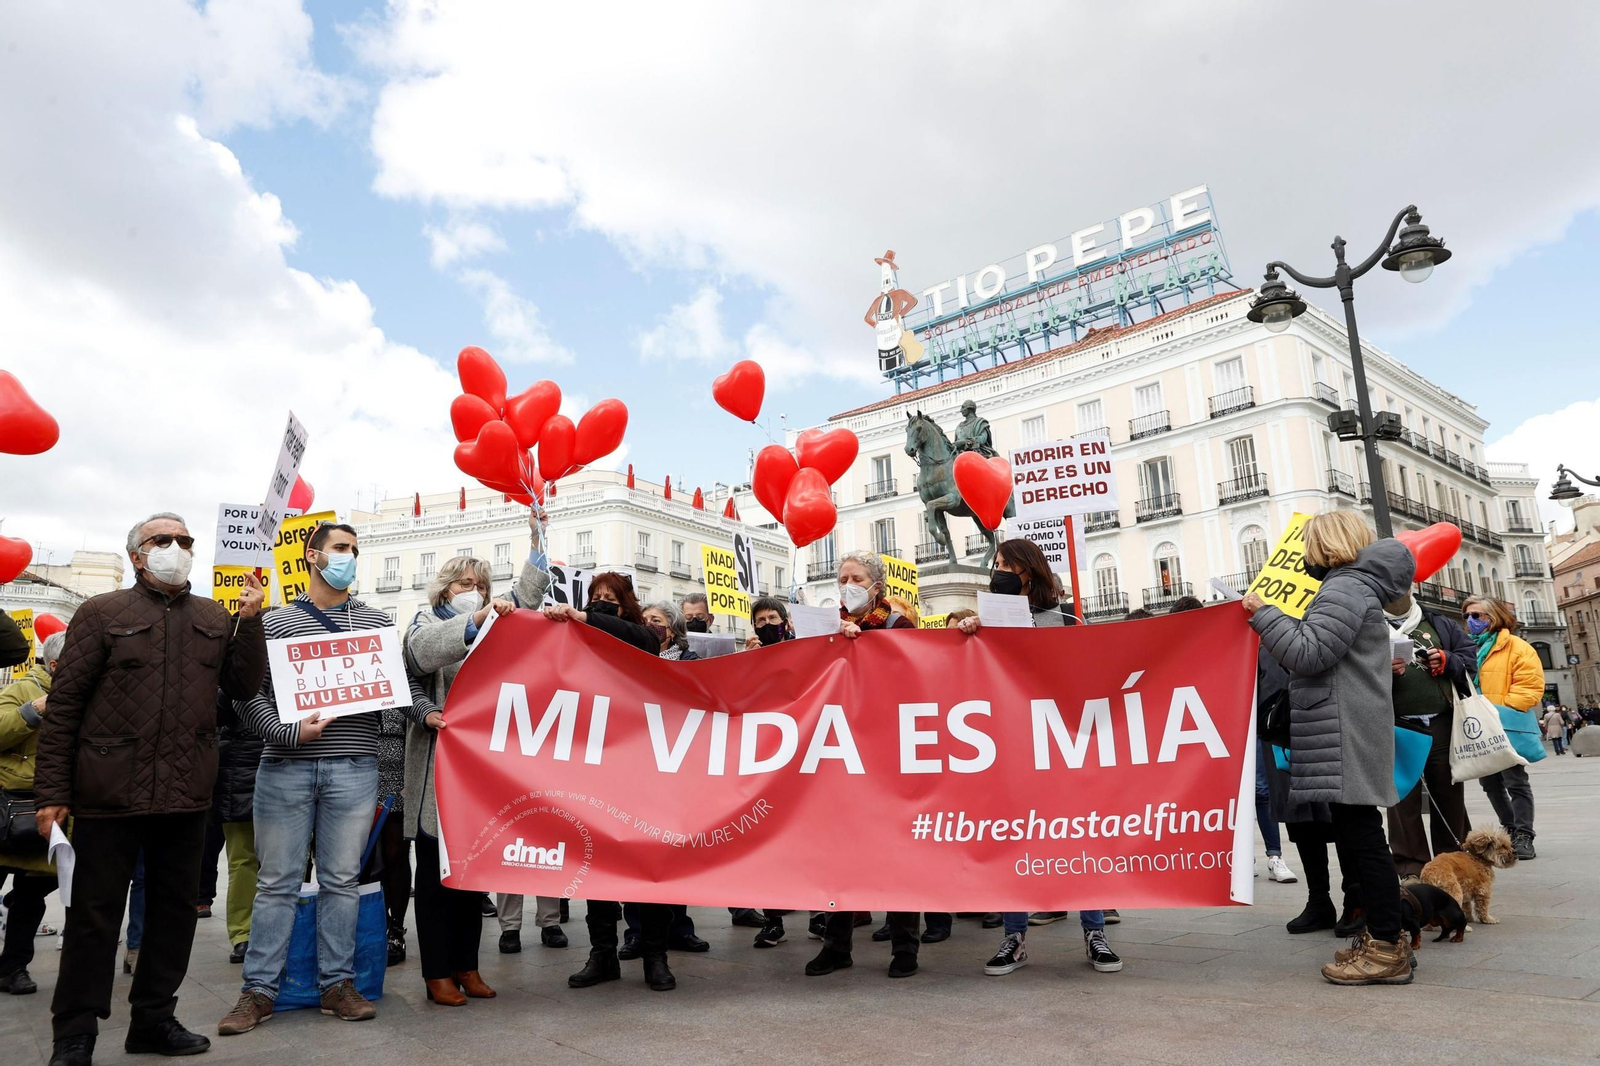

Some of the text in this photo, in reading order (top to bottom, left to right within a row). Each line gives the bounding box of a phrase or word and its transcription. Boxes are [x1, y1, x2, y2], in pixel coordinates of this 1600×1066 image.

[923, 182, 1213, 319] TIO PEPE
[924, 321, 954, 341] SOL
[958, 311, 977, 329] DE
[1077, 231, 1213, 288] EMBOTELLADO
[1014, 441, 1106, 466] MORIR EN
[1014, 460, 1112, 485] PAZ ES UN
[1021, 481, 1109, 505] DERECHO
[224, 508, 248, 520] POR
[228, 525, 243, 534] DE
[1017, 522, 1031, 531] YO
[1057, 530, 1064, 539] Y
[1038, 541, 1066, 552] ANDO
[282, 559, 292, 575] a
[707, 551, 735, 571] ¡NADI
[735, 533, 755, 594] SÍ
[1046, 554, 1062, 563] RIR
[214, 571, 269, 588] Dereo
[1252, 576, 1297, 604] POR
[283, 582, 306, 605] EN
[711, 592, 750, 614] POR TÍ!
[291, 639, 380, 660] BUENA
[292, 653, 382, 675] VIDA
[296, 668, 386, 691] BUENA
[299, 682, 389, 707] MUERTE
[489, 670, 1231, 776] MI VIDA ES MÍA
[514, 807, 538, 822] MORRER
[529, 790, 542, 799] BIZI
[544, 790, 565, 798] VIURE
[568, 792, 587, 803] VIVIR
[588, 796, 605, 810] BIZI
[606, 805, 631, 825] VIURE
[633, 817, 661, 840] VIVIR
[661, 830, 686, 849] BIZI
[688, 825, 734, 849] VIURE
[730, 797, 774, 836] VIVIR
[550, 806, 577, 825] MORIR
[911, 798, 1236, 842] #libreshastaelfinal
[573, 820, 594, 860] MORRER
[503, 837, 566, 867] dmd
[578, 861, 592, 878] HIL
